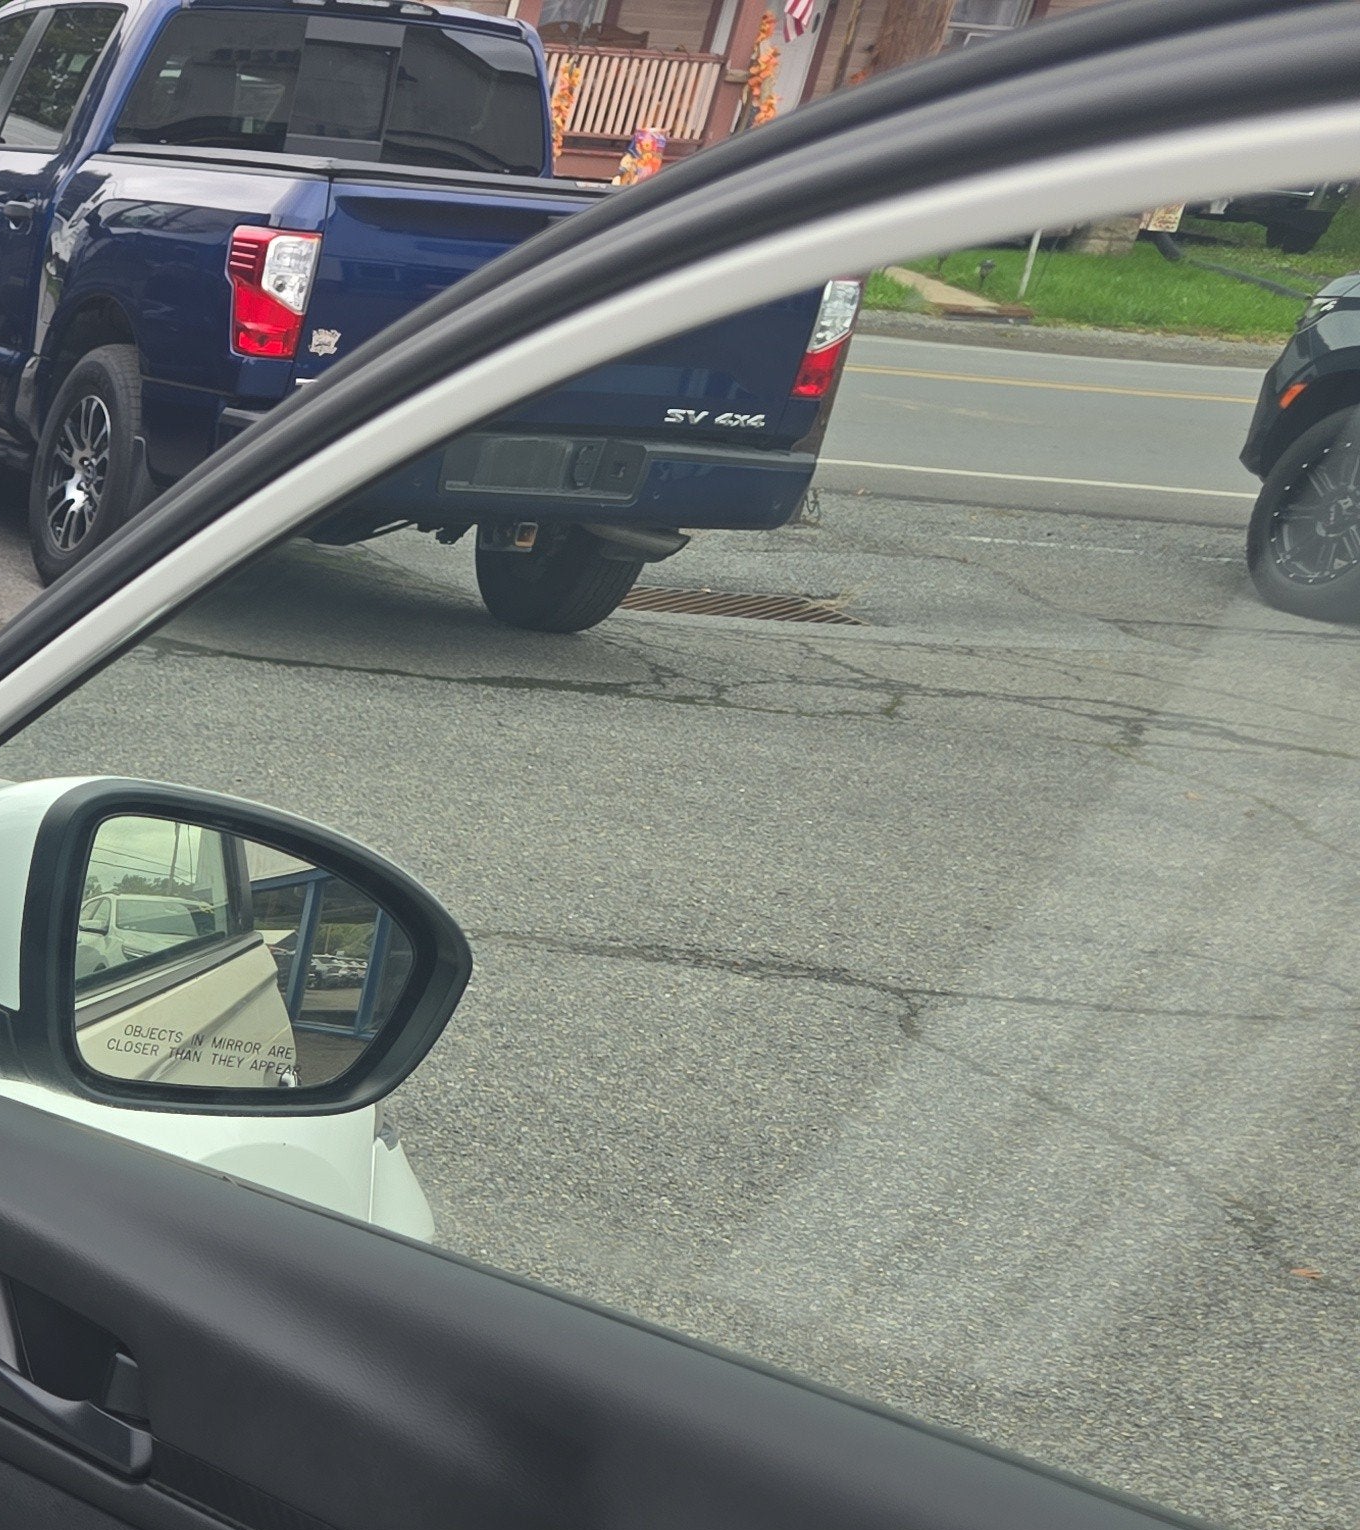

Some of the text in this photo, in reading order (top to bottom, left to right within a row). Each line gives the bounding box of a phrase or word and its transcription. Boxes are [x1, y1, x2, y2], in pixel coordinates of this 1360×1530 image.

[664, 409, 709, 425] SV
[107, 1038, 302, 1077] CLOSER THAN THEY APPEAR
[124, 1024, 295, 1060] OBJECTS IN MIRROR ARE
